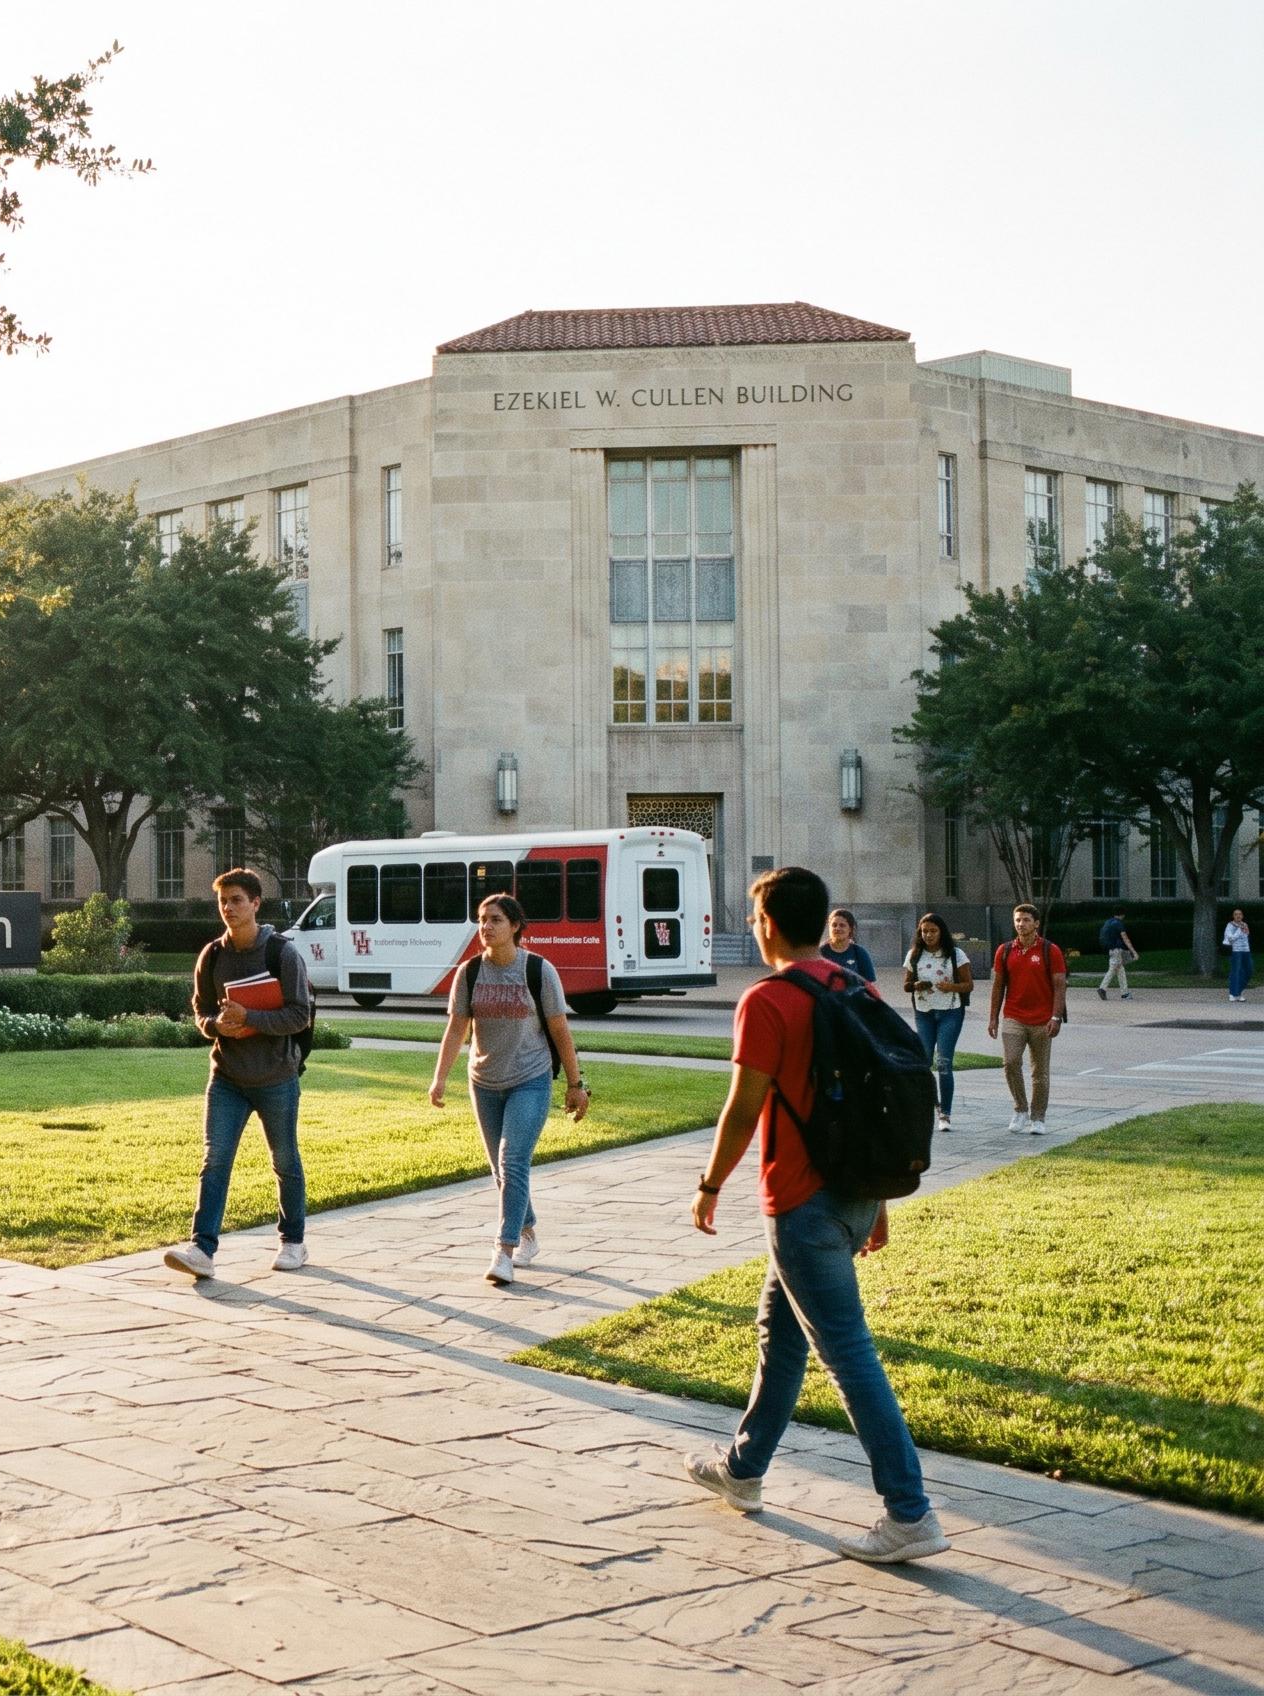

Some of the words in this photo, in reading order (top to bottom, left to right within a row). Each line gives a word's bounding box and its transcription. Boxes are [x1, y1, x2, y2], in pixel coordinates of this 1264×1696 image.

[493, 391, 586, 411] EZEKIEL
[595, 390, 621, 408] W.
[631, 388, 724, 407] CULLEN
[737, 384, 853, 405] BUILDING
